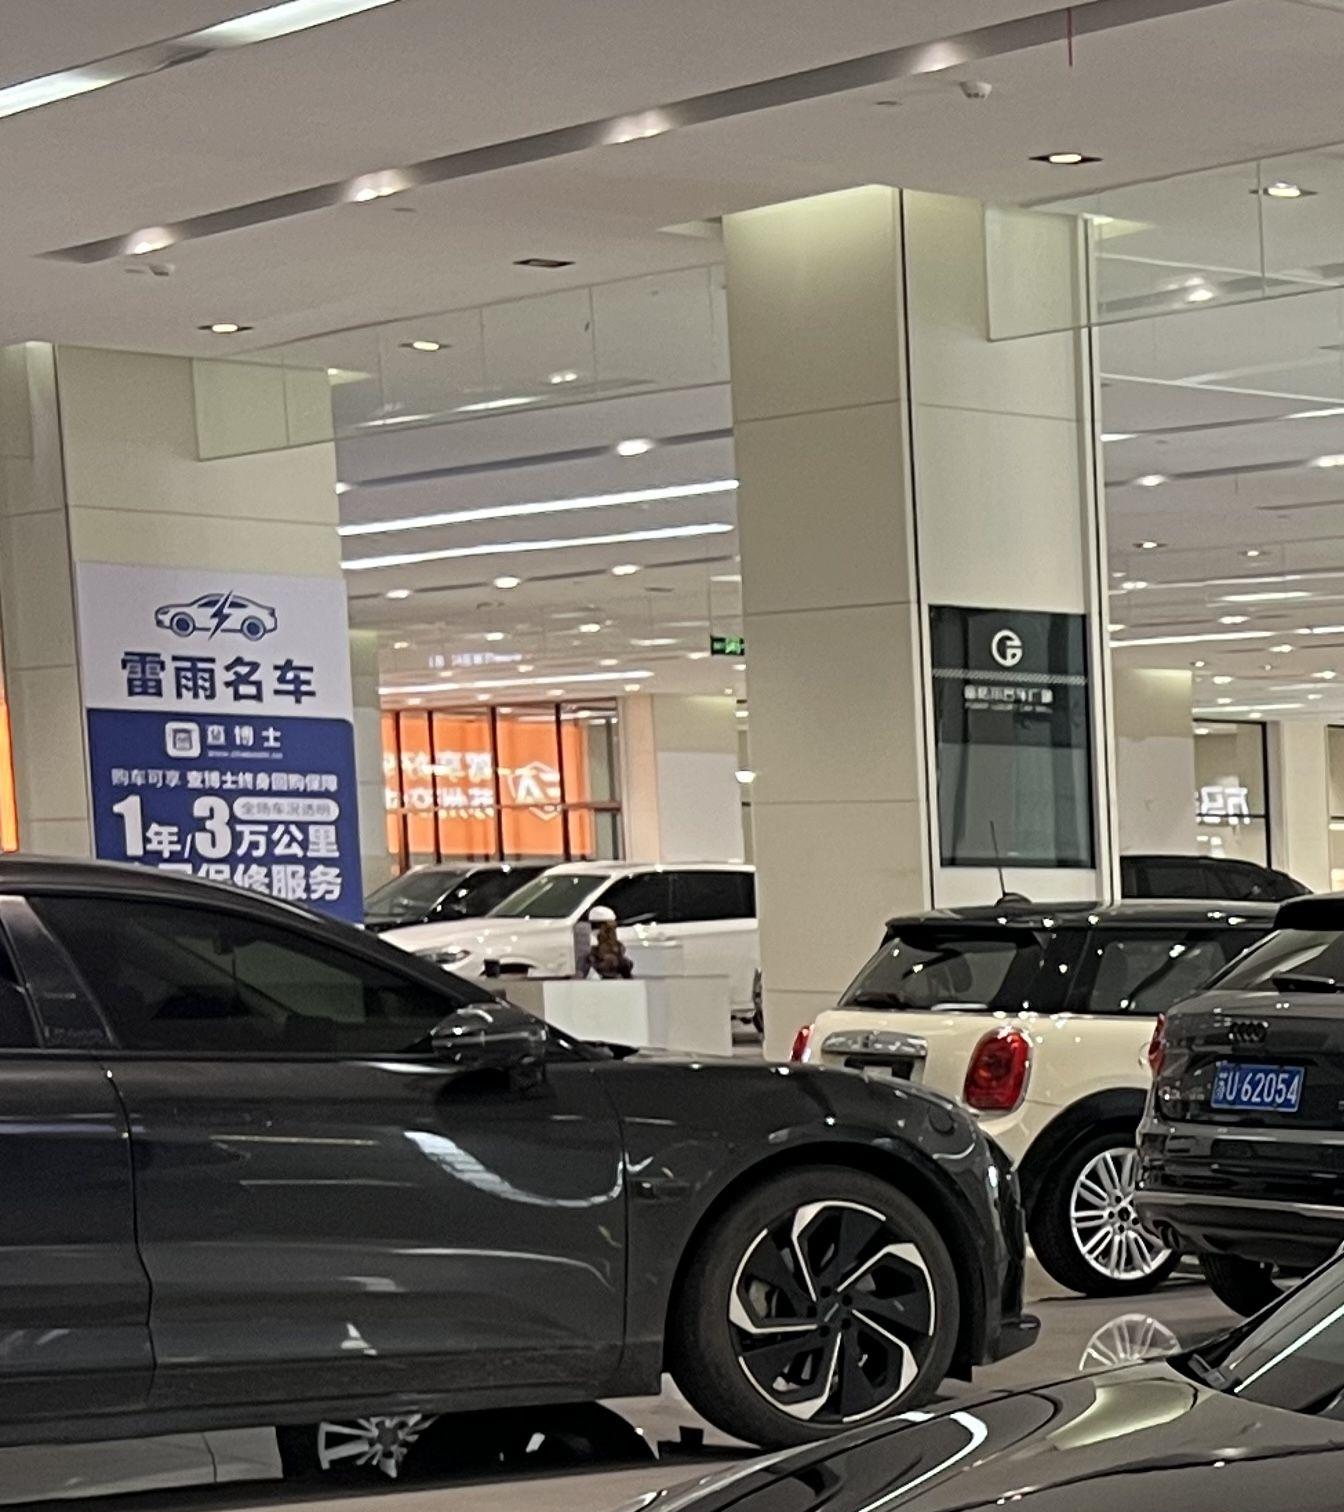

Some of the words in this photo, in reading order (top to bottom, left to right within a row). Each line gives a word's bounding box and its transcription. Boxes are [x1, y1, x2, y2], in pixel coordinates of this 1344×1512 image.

[121, 651, 316, 704] 雷雨名车
[111, 768, 181, 788] 购车可享
